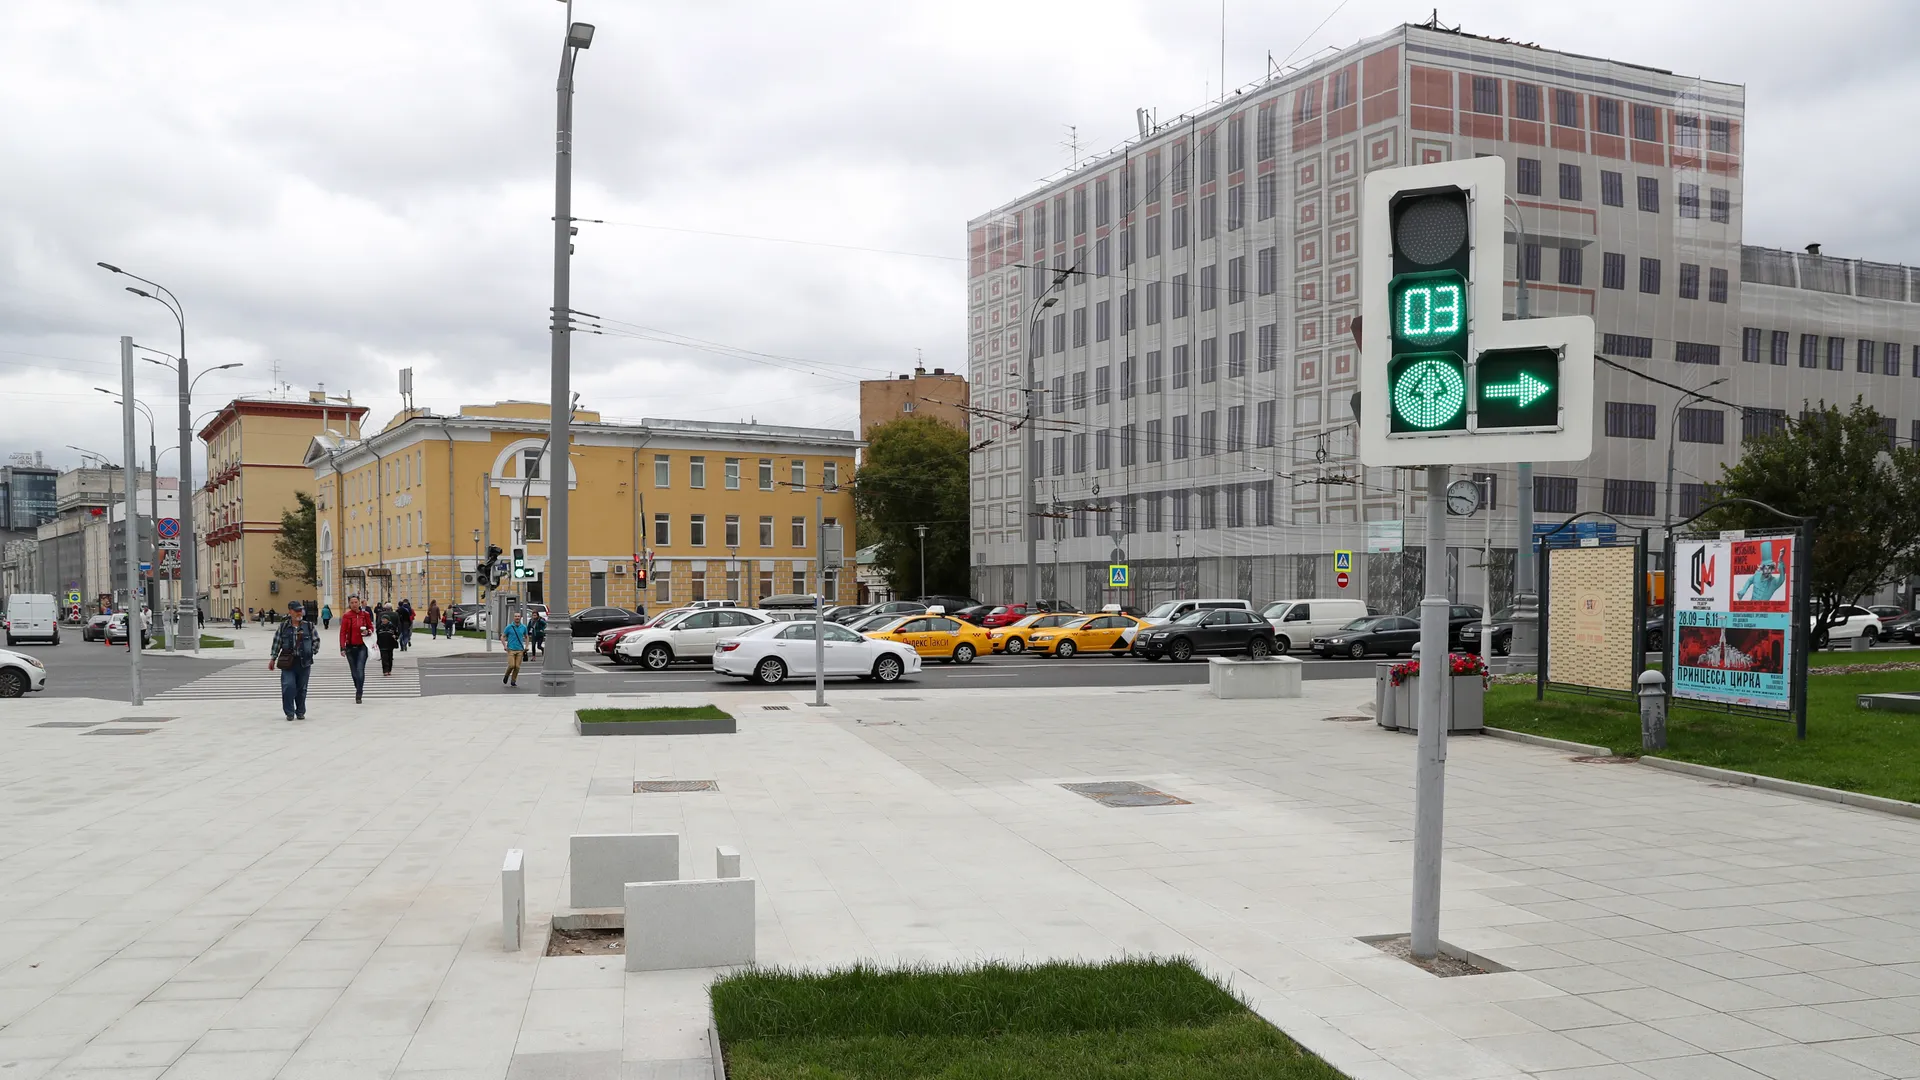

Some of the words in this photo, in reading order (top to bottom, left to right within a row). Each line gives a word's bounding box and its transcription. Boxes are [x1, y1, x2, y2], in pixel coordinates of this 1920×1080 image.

[1404, 285, 1459, 335] 03
[1678, 611, 1697, 626] 28.09
[929, 637, 948, 647] Такси
[1677, 667, 1726, 686] ПРИНЦЕССА
[1730, 671, 1761, 689] ЦИРКА
